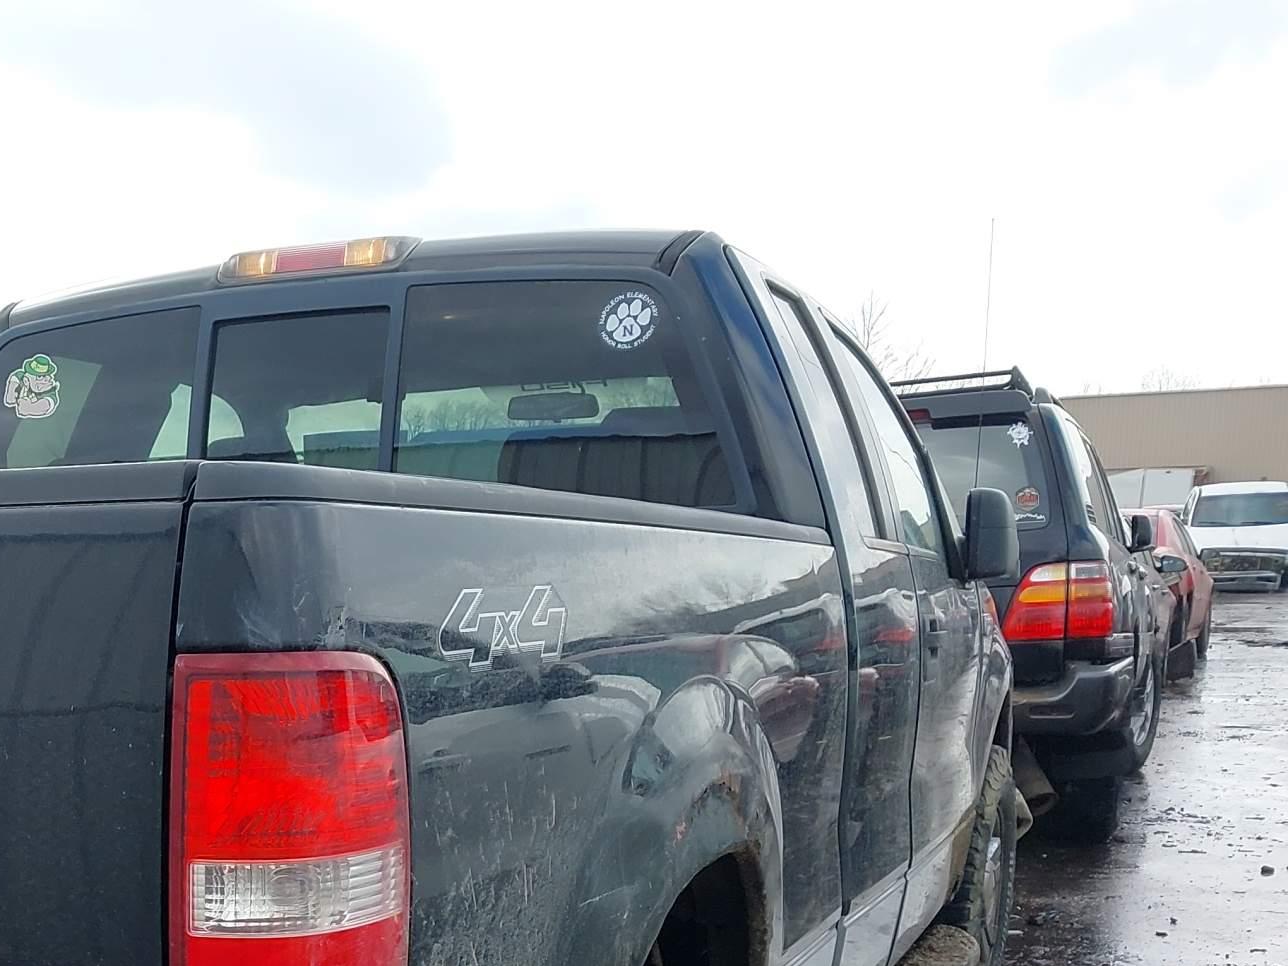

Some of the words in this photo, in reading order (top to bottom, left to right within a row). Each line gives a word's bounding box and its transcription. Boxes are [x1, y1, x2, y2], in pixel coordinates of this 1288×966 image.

[599, 294, 625, 325] NAPOLEON
[626, 291, 659, 317] ELEMENTARY
[622, 324, 634, 337] N
